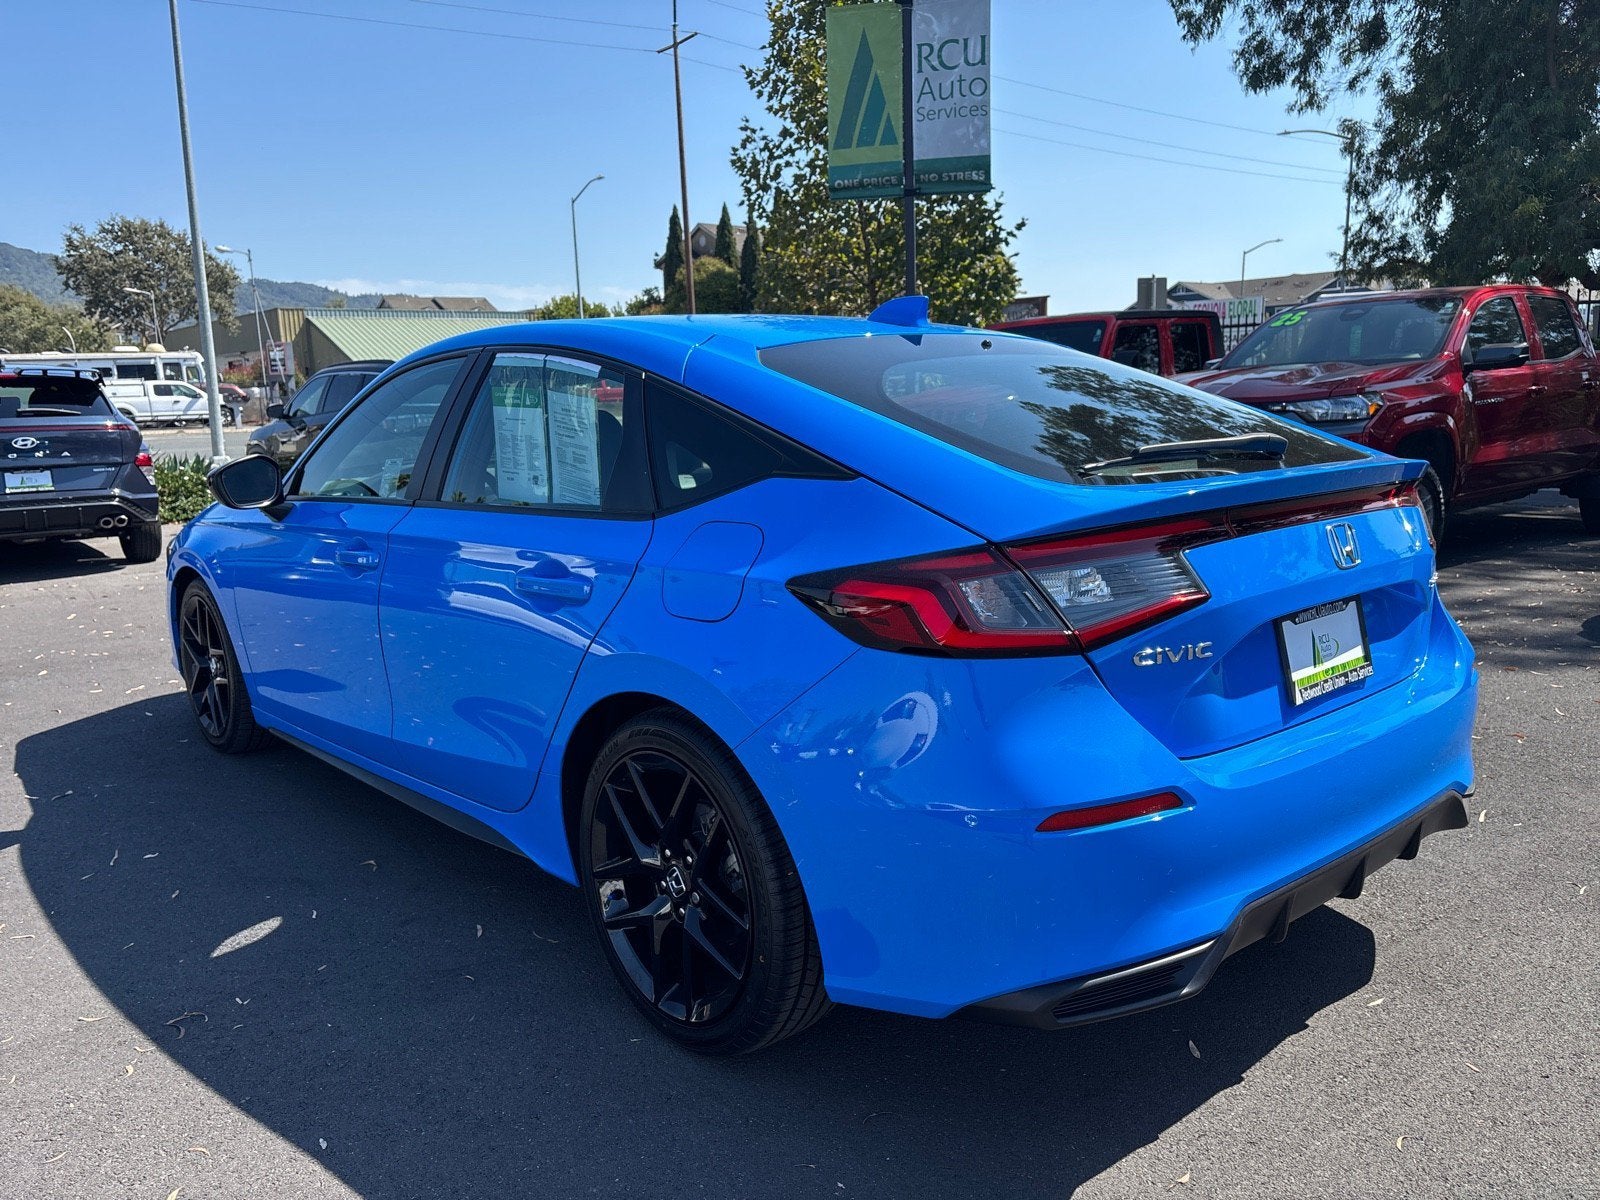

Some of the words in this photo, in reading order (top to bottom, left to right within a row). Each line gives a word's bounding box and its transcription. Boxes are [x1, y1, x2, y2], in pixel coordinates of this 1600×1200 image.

[916, 34, 987, 73] RCU
[916, 74, 988, 104] Auto
[916, 103, 988, 122] Services
[834, 177, 860, 189] ONE
[864, 175, 898, 188] PRICE
[920, 173, 938, 182] NO
[942, 170, 986, 182] STRESS
[1270, 310, 1308, 327] 25
[1133, 641, 1214, 667] CIVIC
